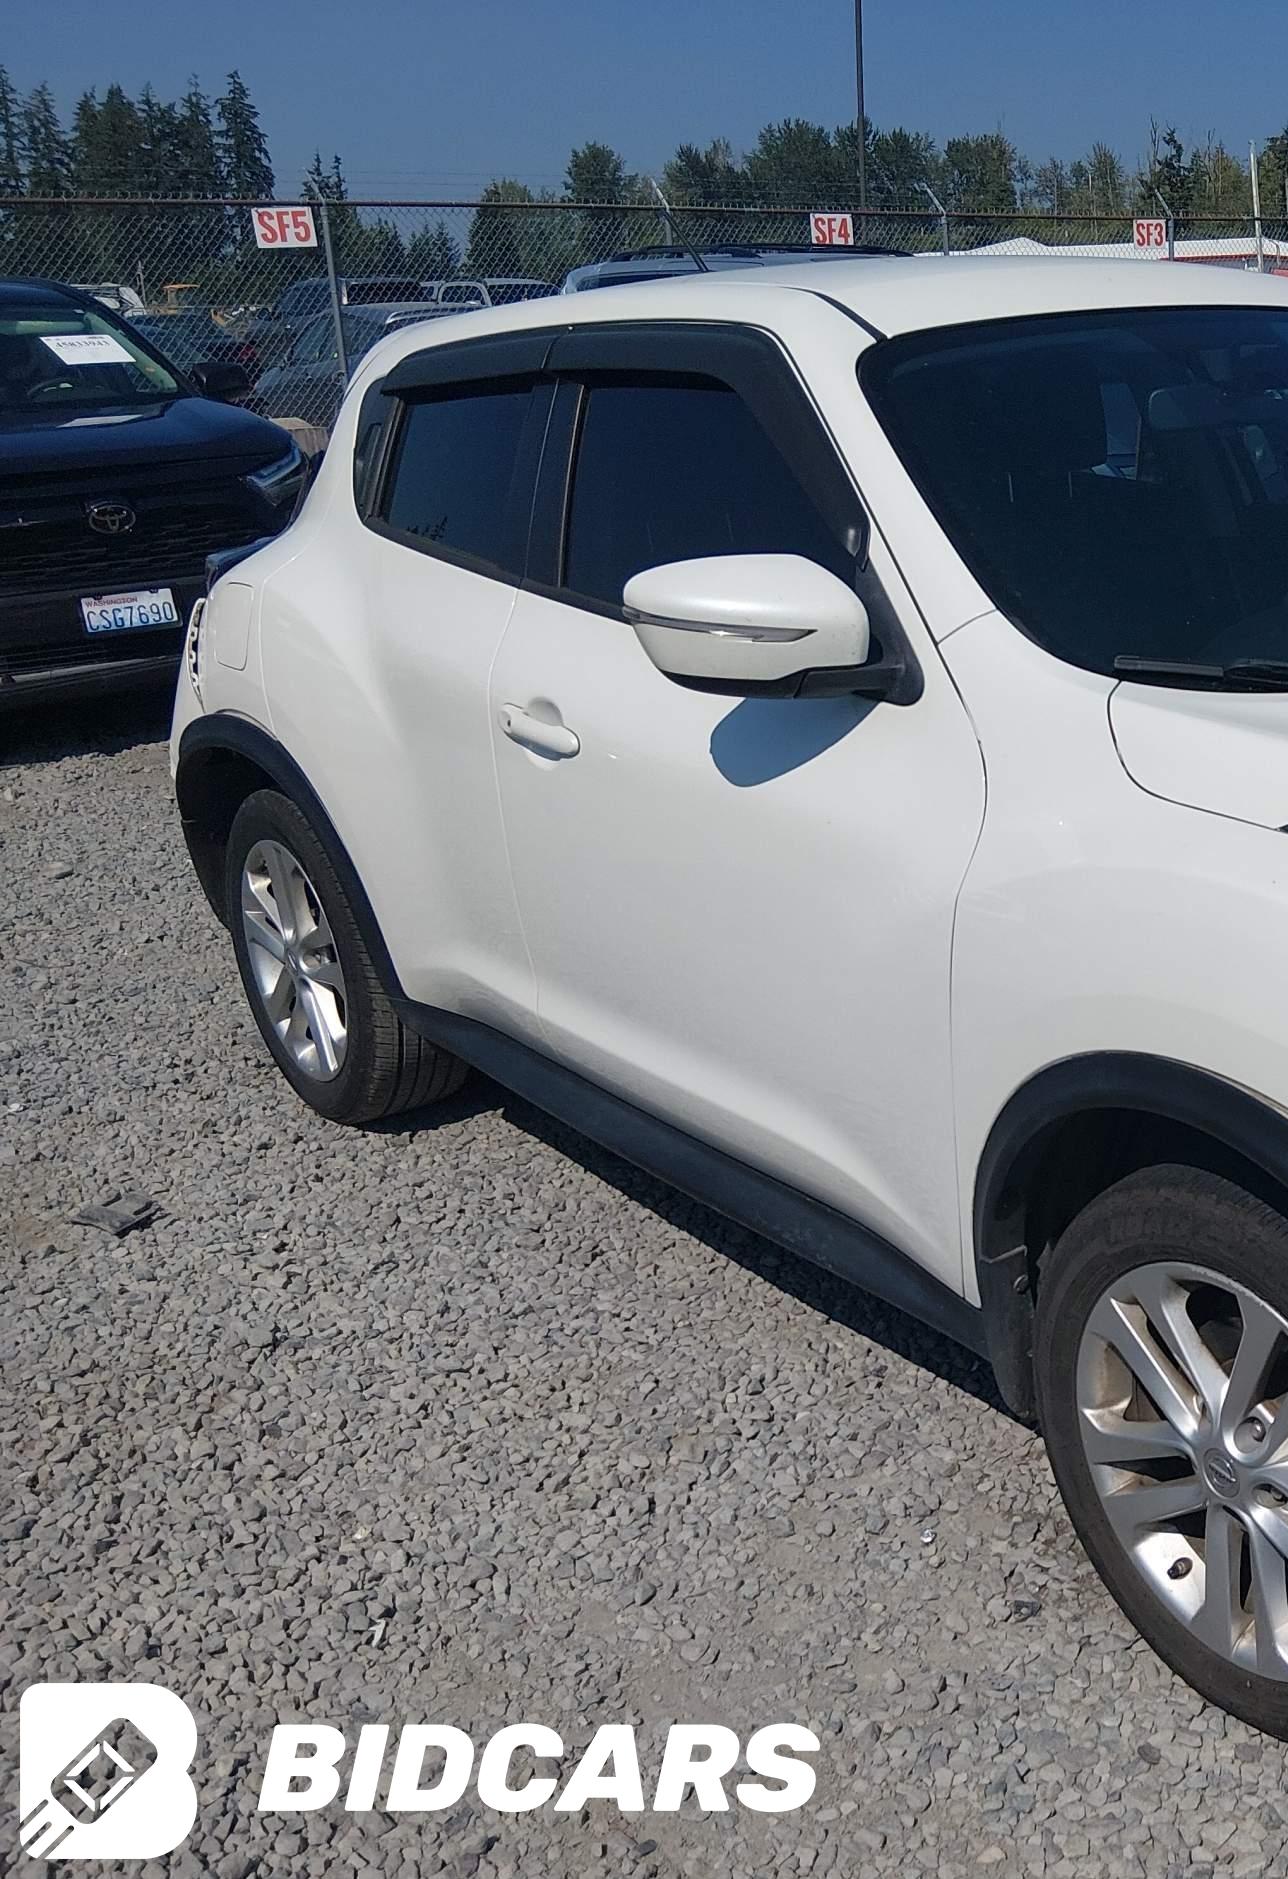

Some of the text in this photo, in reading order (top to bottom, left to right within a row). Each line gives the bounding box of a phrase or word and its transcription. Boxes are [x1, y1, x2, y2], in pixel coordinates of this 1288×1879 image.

[257, 210, 311, 243] SF5
[814, 217, 850, 245] SF4
[1136, 223, 1164, 247] SF3
[85, 596, 138, 608] WASHINGTON
[87, 601, 174, 631] CSG7690
